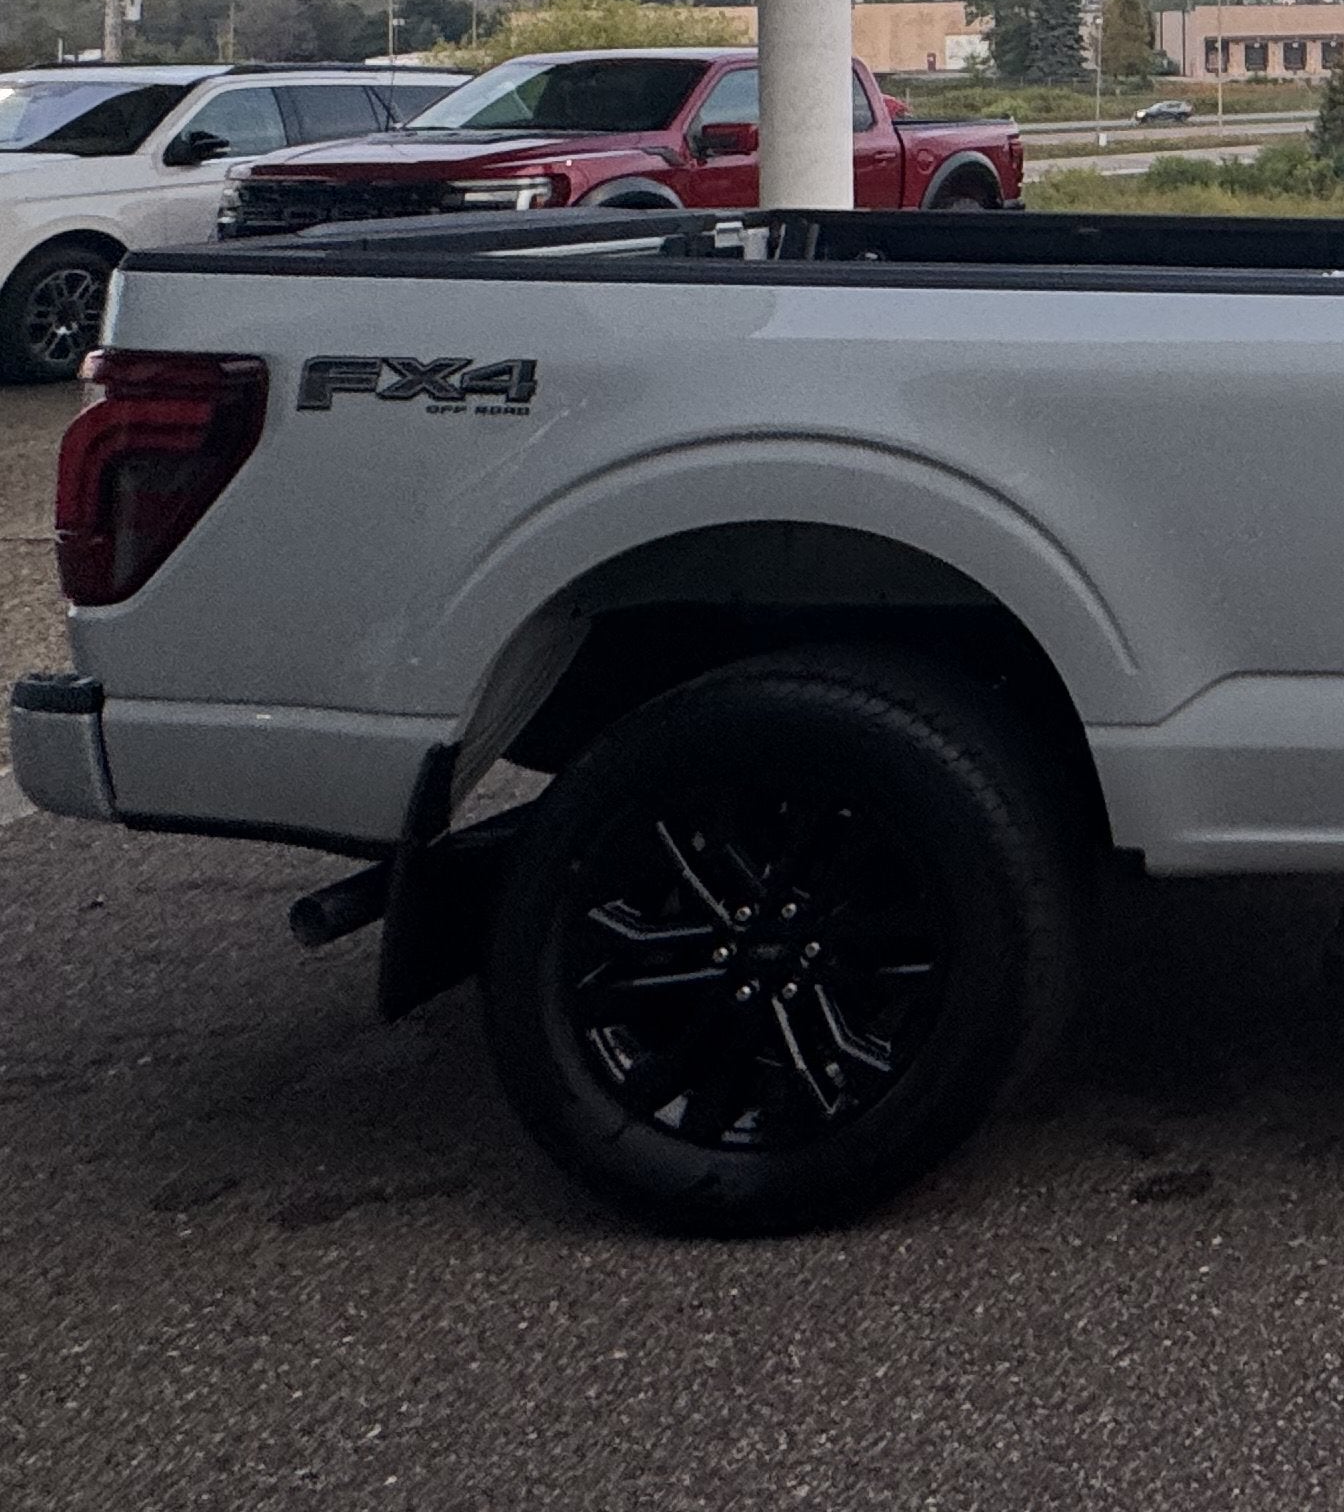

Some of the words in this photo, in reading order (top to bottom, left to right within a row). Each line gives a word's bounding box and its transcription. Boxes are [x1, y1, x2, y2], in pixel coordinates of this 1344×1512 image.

[297, 355, 538, 411] FX4
[426, 404, 468, 414] OFF
[475, 405, 530, 416] ROAD
